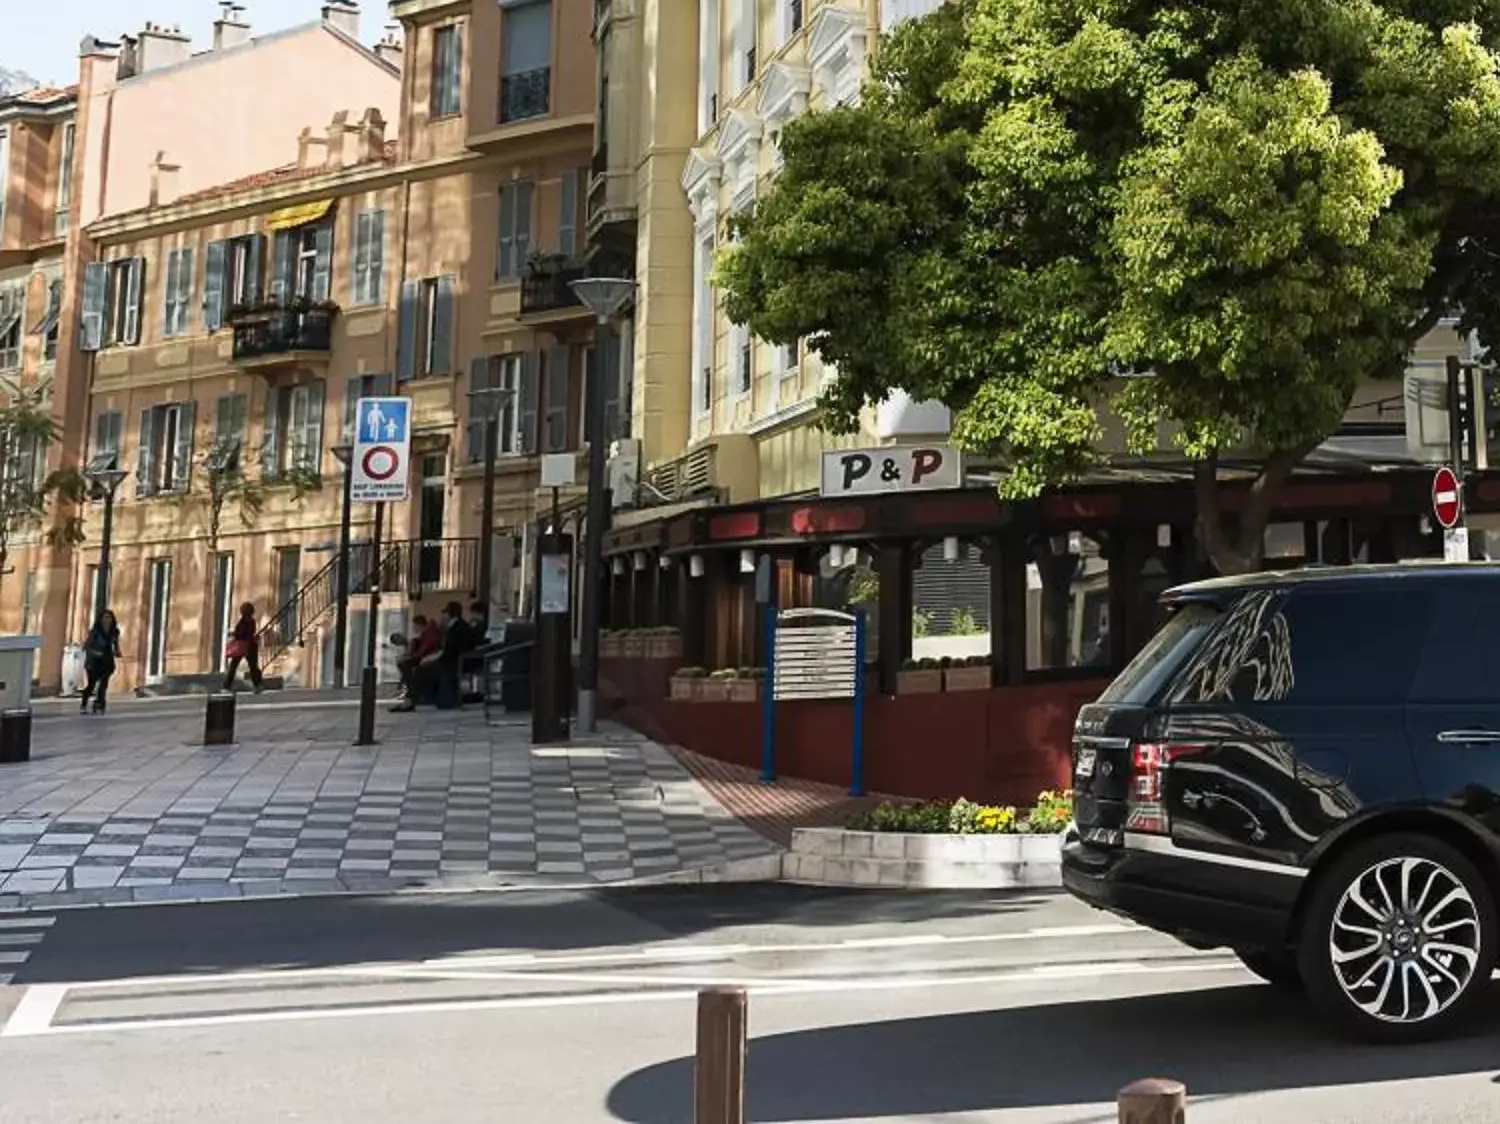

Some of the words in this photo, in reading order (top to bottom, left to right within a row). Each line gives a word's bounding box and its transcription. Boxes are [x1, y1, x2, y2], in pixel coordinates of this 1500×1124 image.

[841, 453, 872, 490] P
[881, 458, 901, 482] &
[911, 449, 943, 485] P
